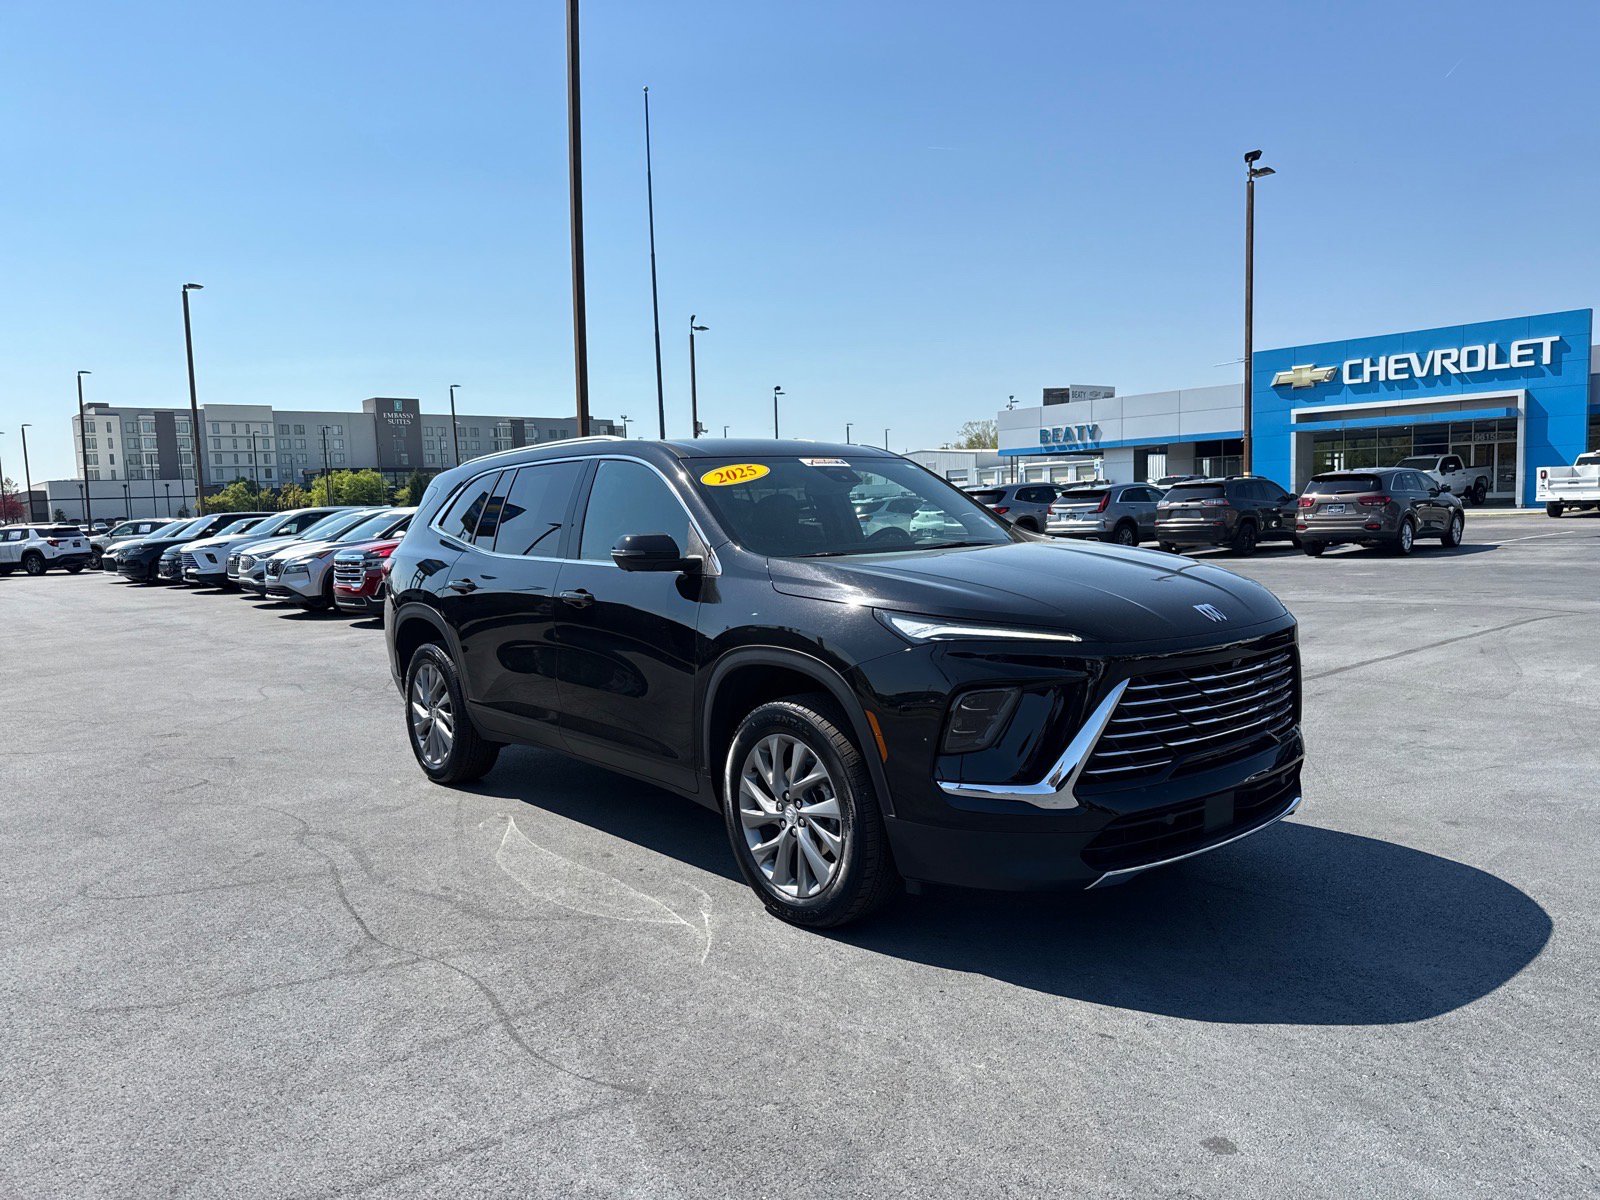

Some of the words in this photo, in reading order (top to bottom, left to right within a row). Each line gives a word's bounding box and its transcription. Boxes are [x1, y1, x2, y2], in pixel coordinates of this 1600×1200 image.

[1343, 336, 1560, 385] CHEVROLET
[1071, 390, 1087, 399] BEATY
[1039, 424, 1098, 444] BEATY
[715, 465, 757, 484] 2025
